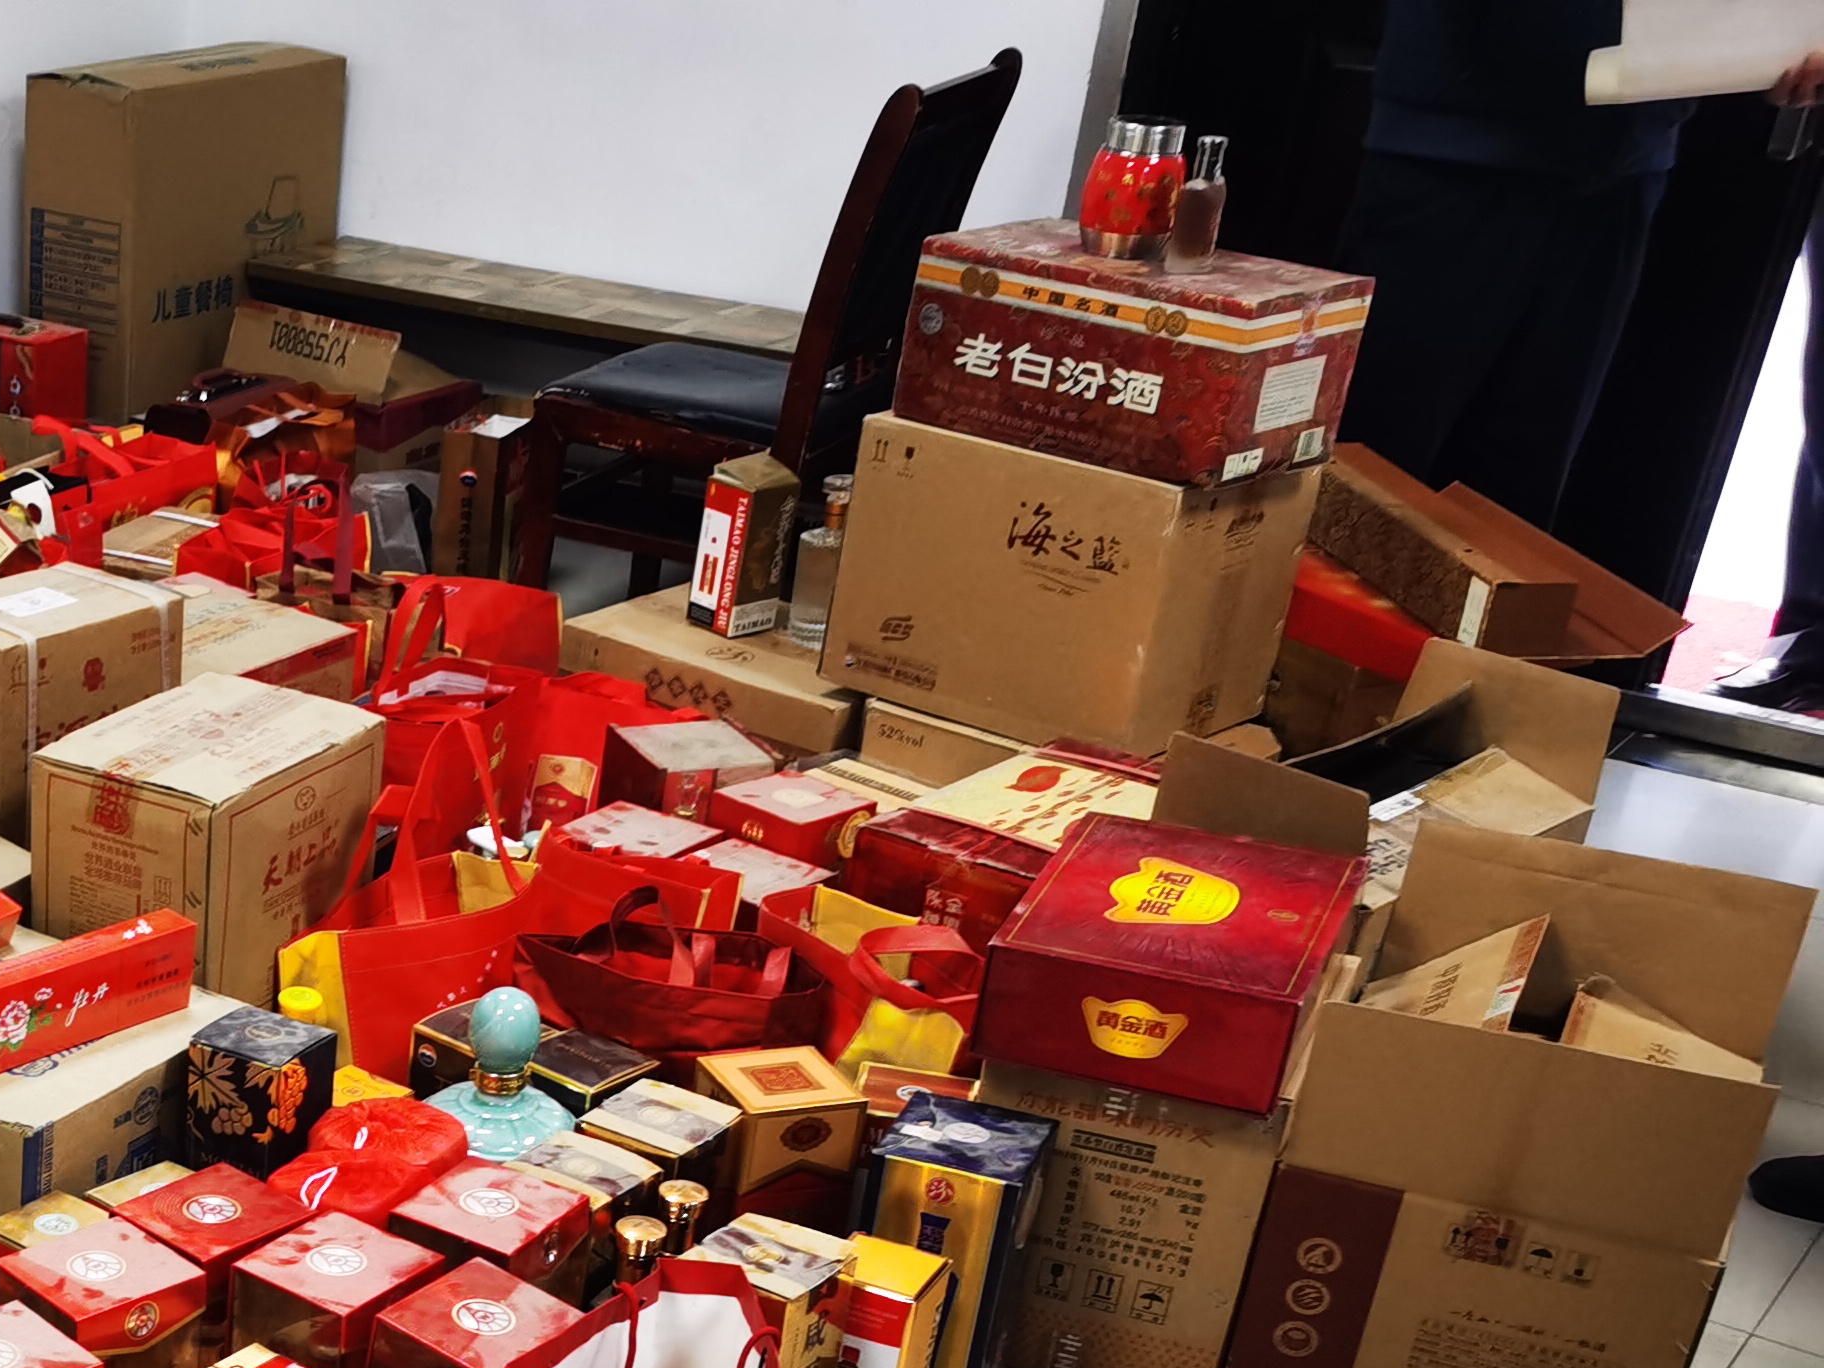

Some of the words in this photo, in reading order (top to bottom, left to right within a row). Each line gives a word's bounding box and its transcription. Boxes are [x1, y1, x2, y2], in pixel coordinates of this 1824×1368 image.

[151, 274, 233, 324] 儿童餐椅
[954, 333, 1164, 415] 老白汾酒
[733, 616, 773, 633] TAIMAO
